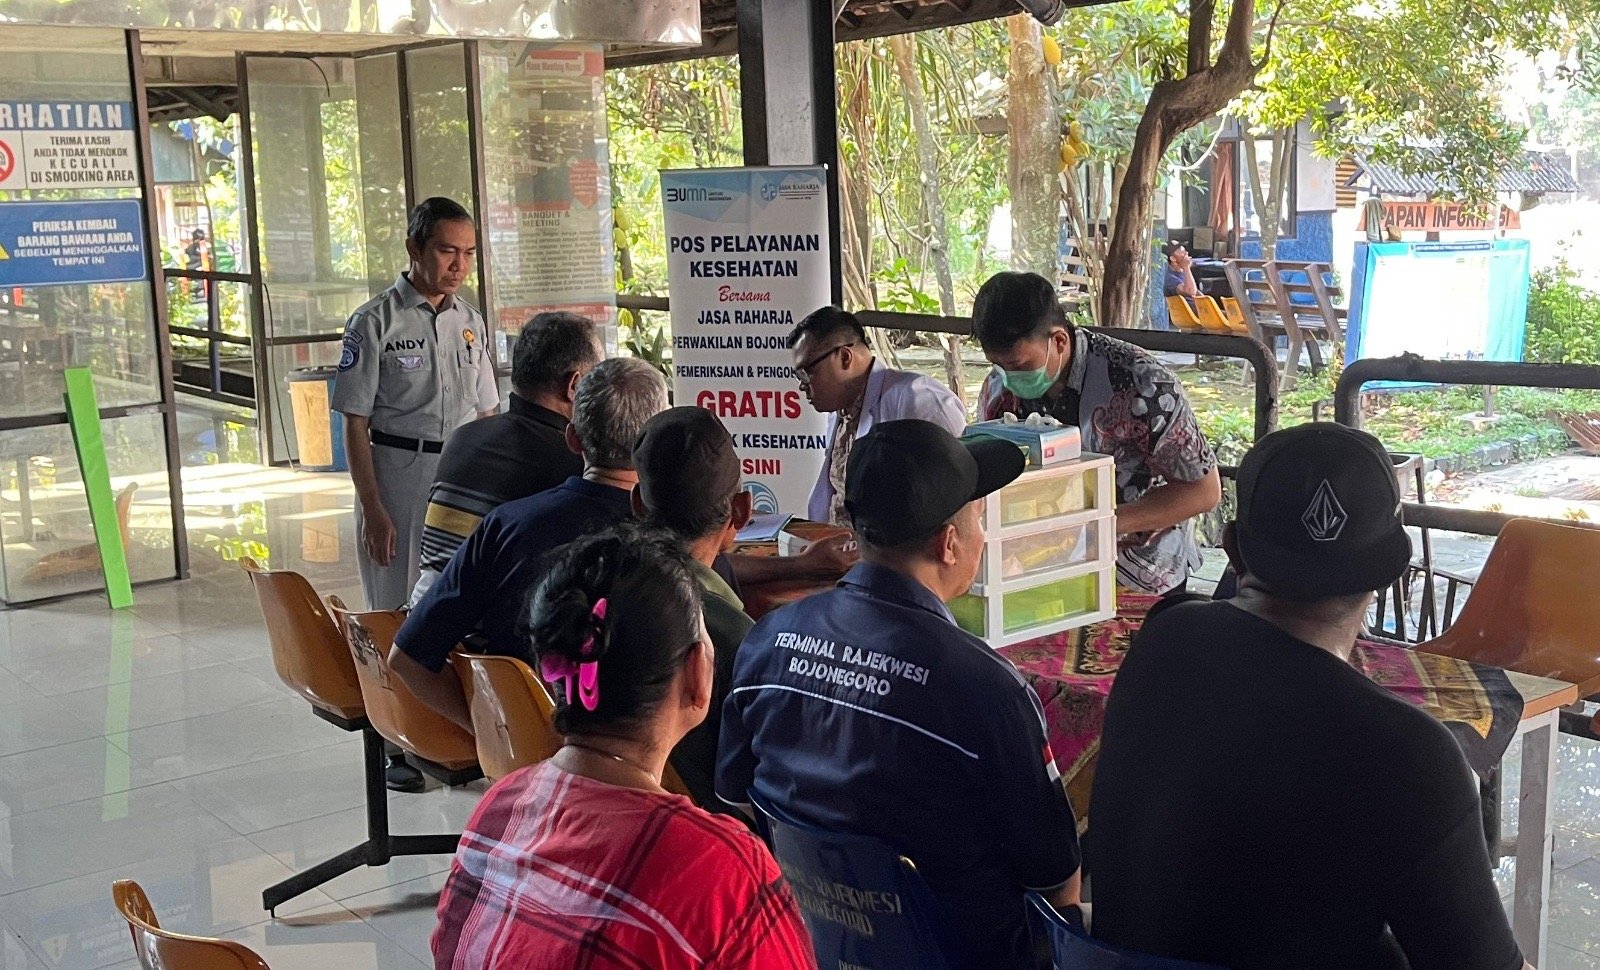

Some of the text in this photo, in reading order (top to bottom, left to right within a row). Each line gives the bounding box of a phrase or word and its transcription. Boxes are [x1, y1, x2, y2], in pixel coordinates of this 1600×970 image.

[0, 103, 123, 129] RHATIAN
[50, 136, 111, 145] TERIMA KASIH
[34, 147, 128, 157] ANDA TIDAK MEROKOK
[31, 170, 134, 183] DI SMOOKING AREA
[522, 211, 561, 220] BANQUET
[522, 219, 560, 227] MEETING
[33, 219, 117, 233] PERIKSA KEMBALI
[18, 232, 134, 247] BARANG BAWAAN ANDA
[670, 234, 820, 253] POS PELAYANAN
[14, 244, 139, 258] SEBELUM MENINGGALKAN
[52, 255, 105, 266] TEMPAT INI
[690, 260, 798, 278] KESEHATAN
[718, 285, 772, 302] Bersama
[697, 310, 794, 325] JASA RAHARJA
[384, 338, 425, 353] ANDY
[746, 335, 793, 350] BOJONE
[676, 365, 795, 378] PEMERIKSAAN & PENGO
[696, 390, 802, 420] GRATIS
[742, 433, 827, 450] KESEHATAN
[740, 458, 781, 475] SINI
[774, 632, 930, 686] TERMINAL RAJEKWESI
[788, 656, 891, 696] BOJONEGORO
